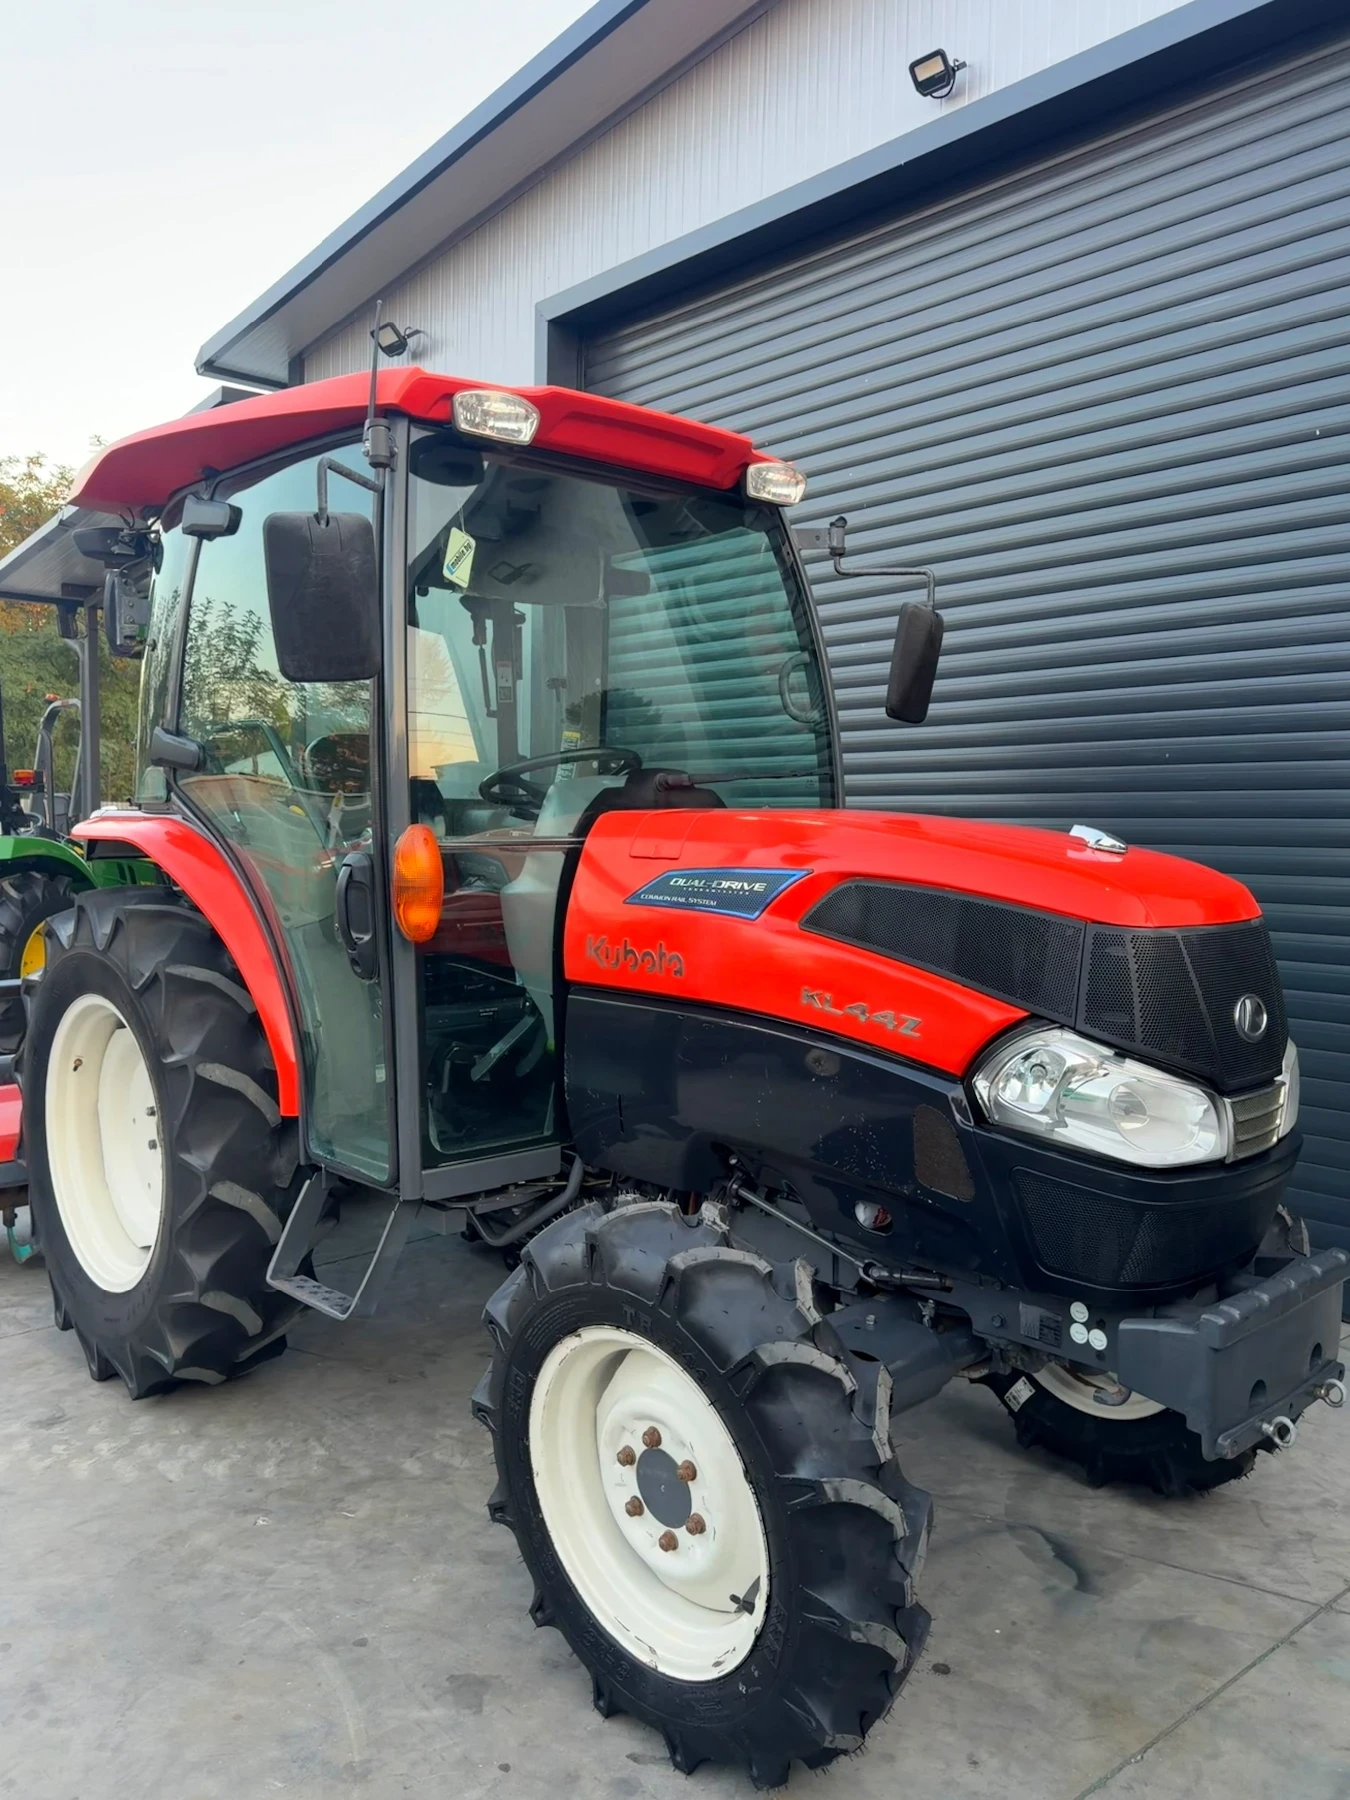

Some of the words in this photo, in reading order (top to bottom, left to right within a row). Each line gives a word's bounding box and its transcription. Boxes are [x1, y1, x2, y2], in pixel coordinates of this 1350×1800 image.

[669, 877, 767, 892] DUAL-DRIVE
[640, 893, 671, 901] COMMON
[688, 897, 717, 906] SYSTEM
[586, 935, 684, 976] Kubota
[802, 987, 921, 1037] KL44Z
